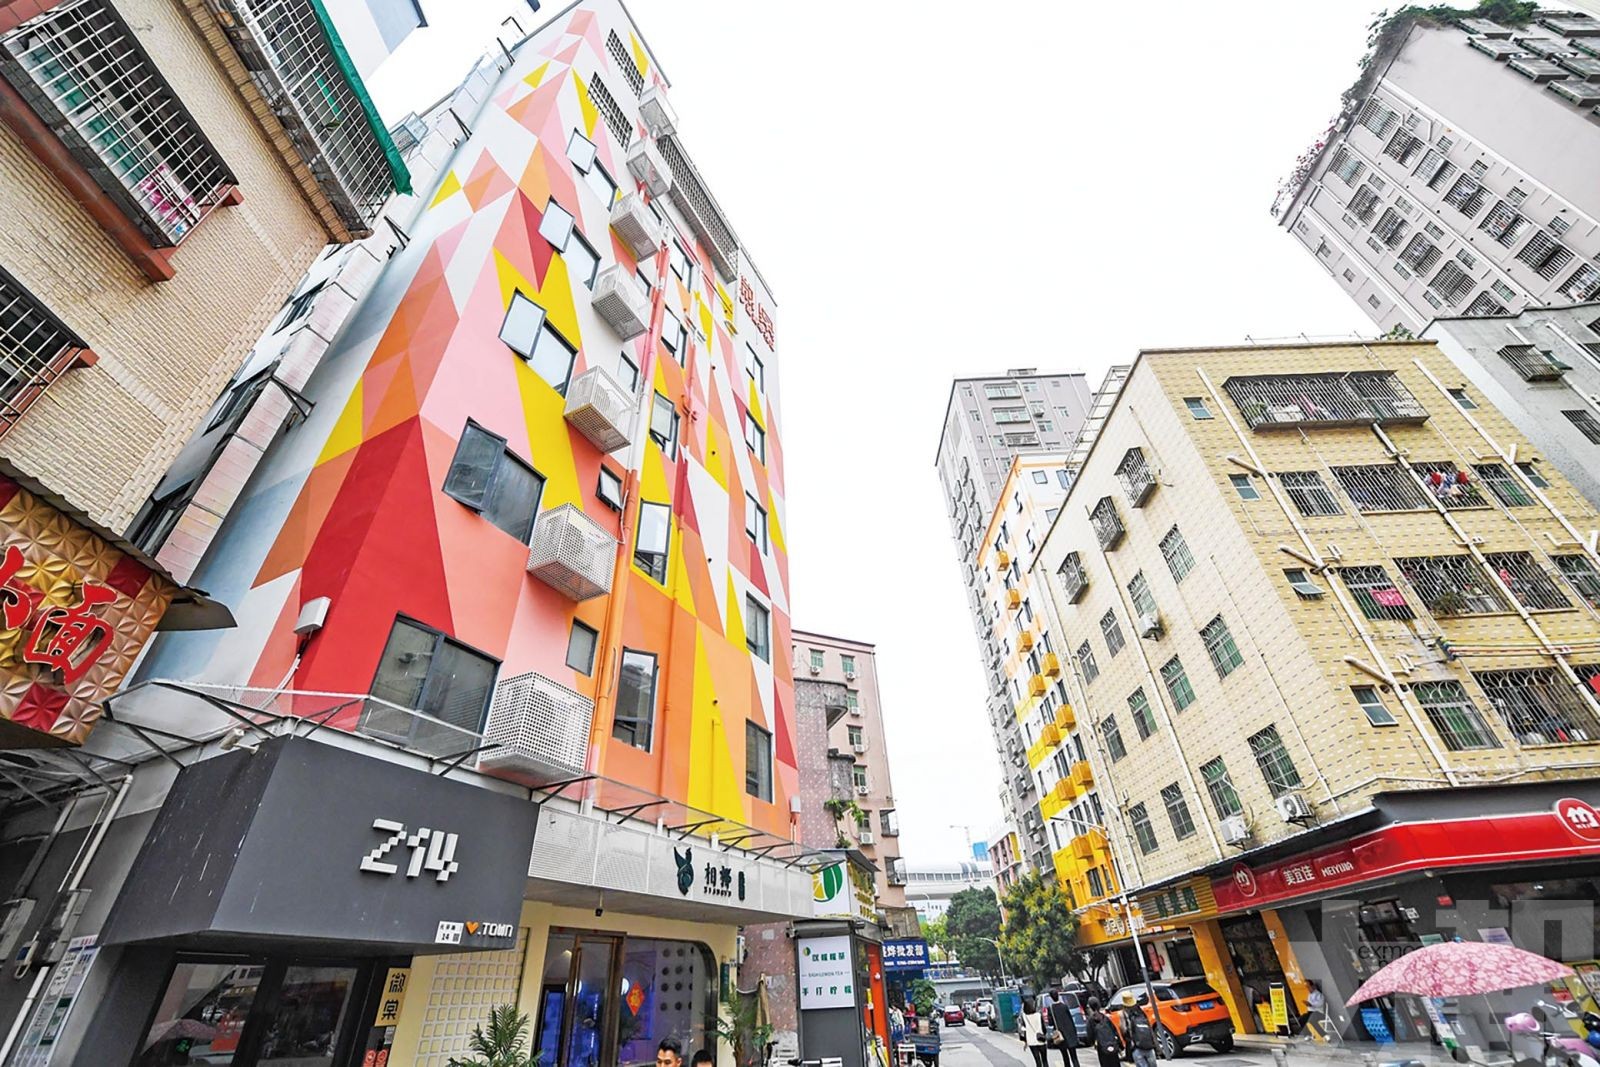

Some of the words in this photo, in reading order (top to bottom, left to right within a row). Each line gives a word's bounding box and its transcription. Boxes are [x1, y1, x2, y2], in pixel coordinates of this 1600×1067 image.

[360, 818, 459, 882] 214
[1283, 865, 1315, 886] 美宜佳
